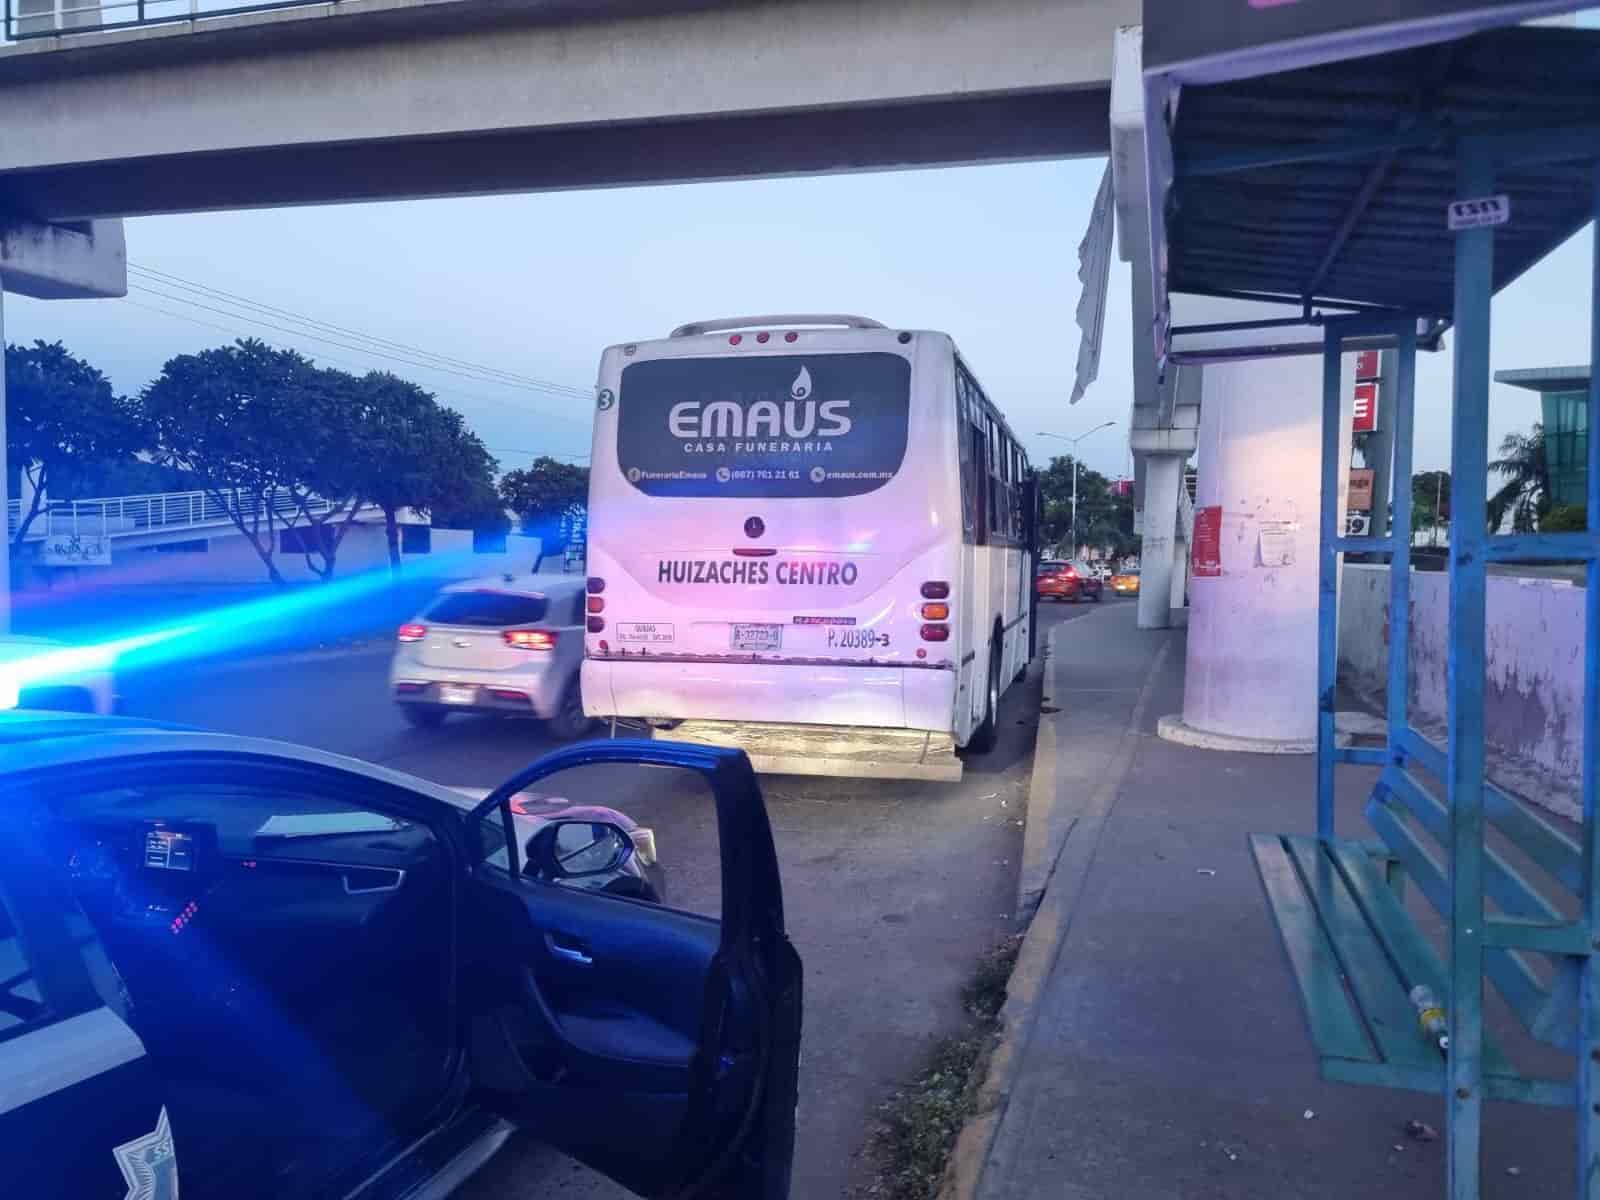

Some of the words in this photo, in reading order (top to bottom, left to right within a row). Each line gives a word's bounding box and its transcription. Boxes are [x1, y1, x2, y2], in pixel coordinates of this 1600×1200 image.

[684, 442, 726, 453] CASA
[735, 441, 833, 453] FUNERARIA
[658, 560, 769, 584] HUIZACHES
[775, 561, 858, 586] CENTRO
